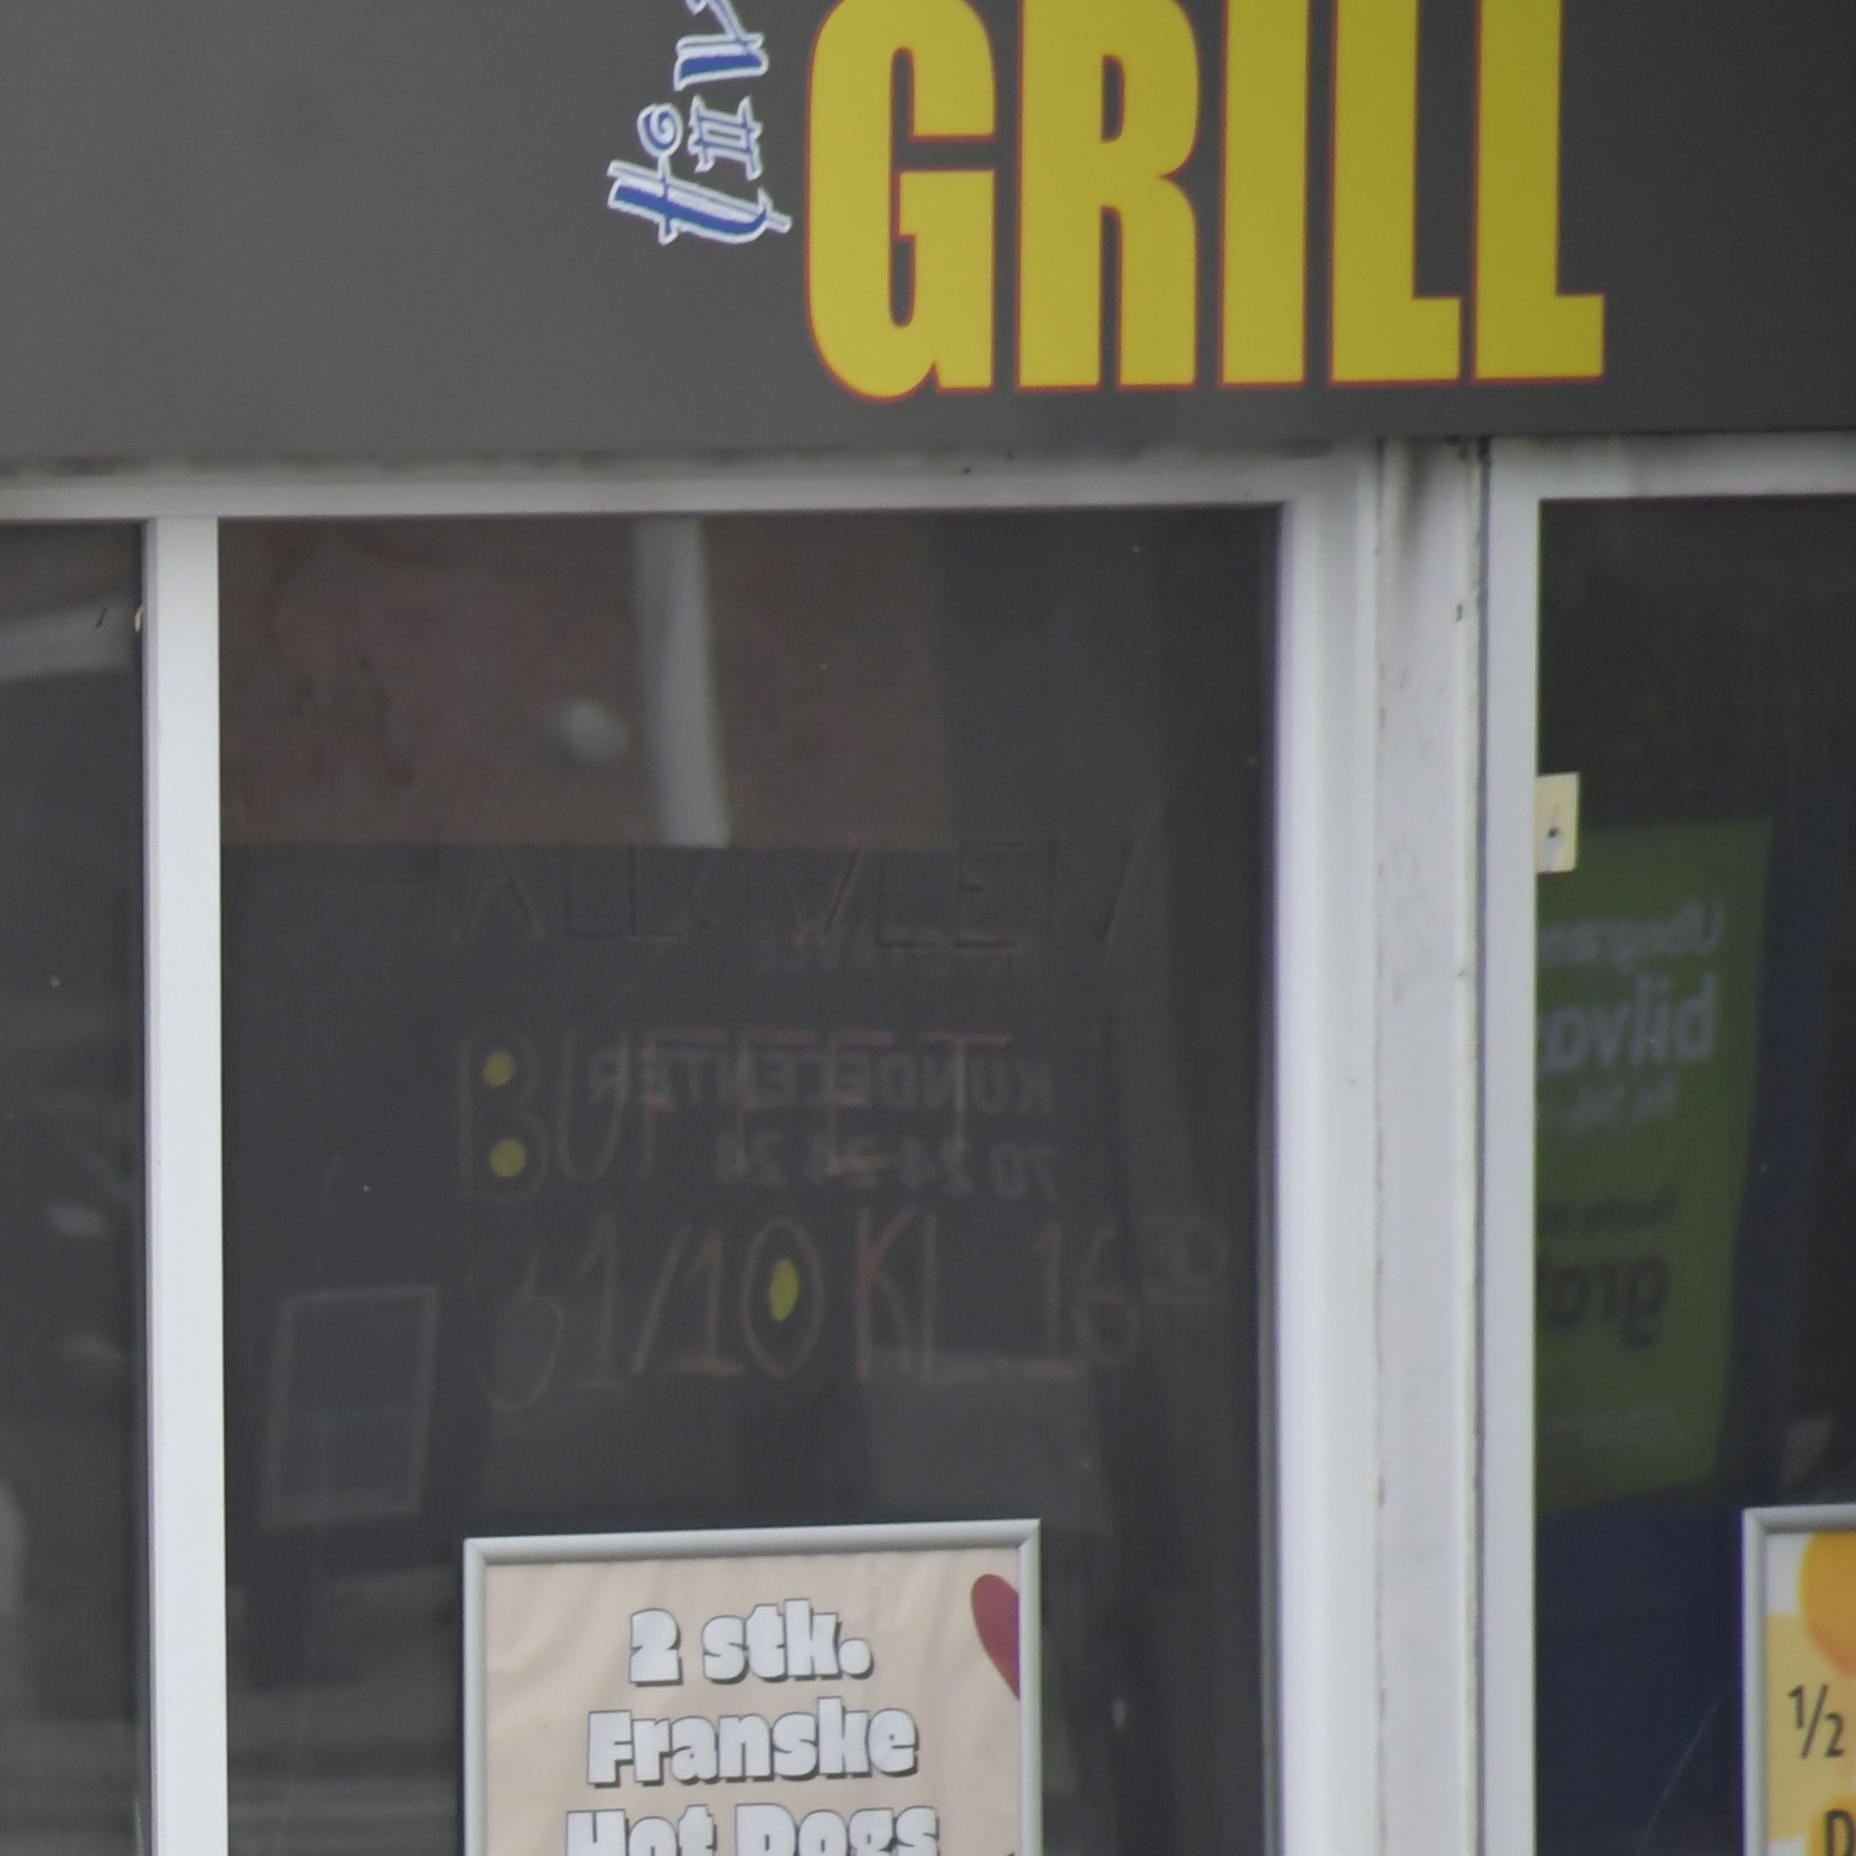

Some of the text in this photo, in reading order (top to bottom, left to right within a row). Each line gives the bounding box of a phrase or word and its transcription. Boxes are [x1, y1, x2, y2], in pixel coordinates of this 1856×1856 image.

[803, 0, 1607, 403] GRILL
[628, 1597, 874, 1689] 2 stk.
[586, 1696, 921, 1787] Franske
